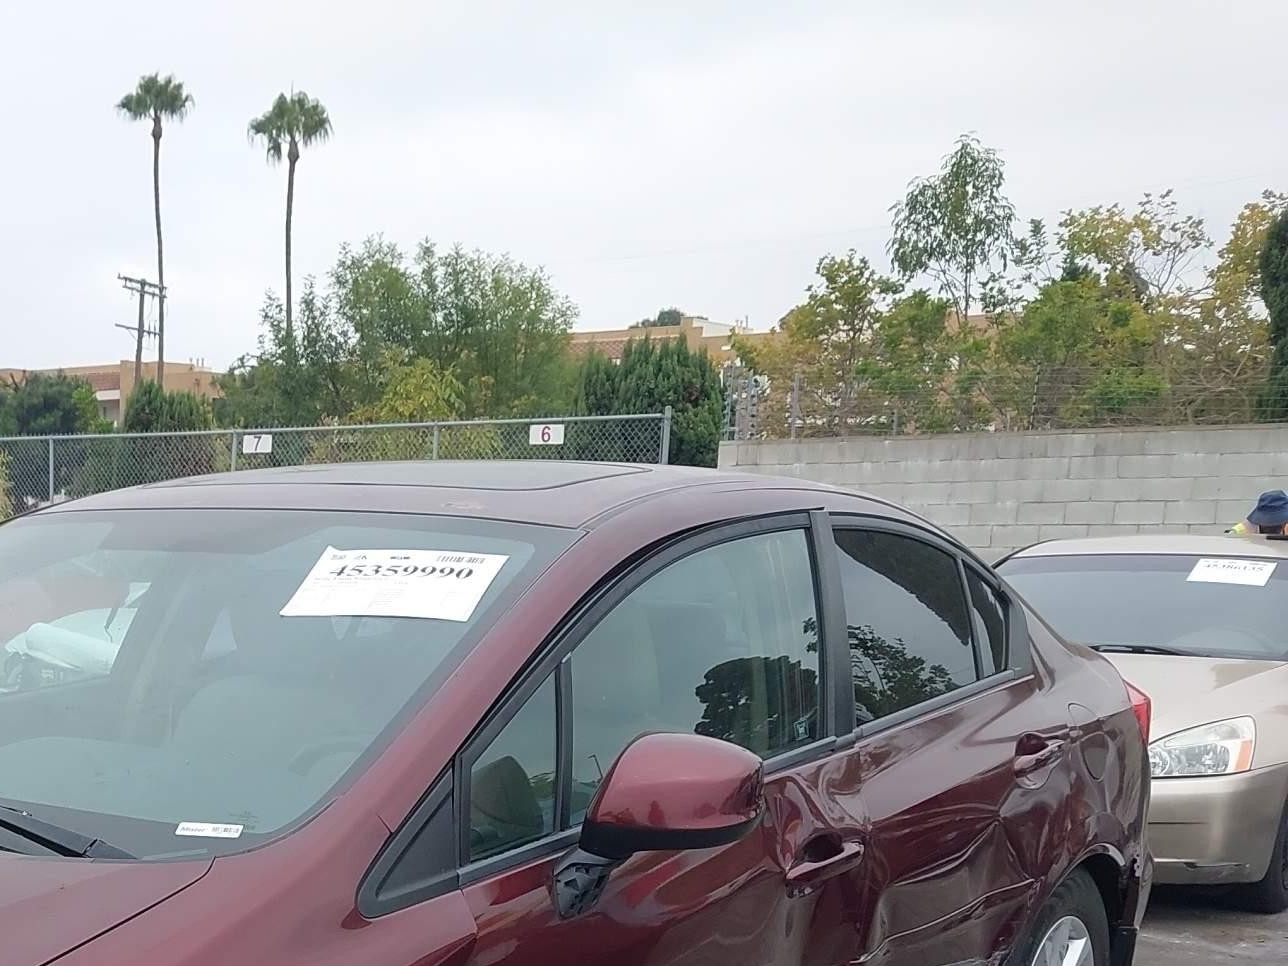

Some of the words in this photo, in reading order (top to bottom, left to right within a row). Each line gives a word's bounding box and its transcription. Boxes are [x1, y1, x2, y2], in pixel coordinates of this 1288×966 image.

[541, 425, 551, 443] 6
[253, 435, 262, 451] 7
[329, 564, 474, 580] 45359990
